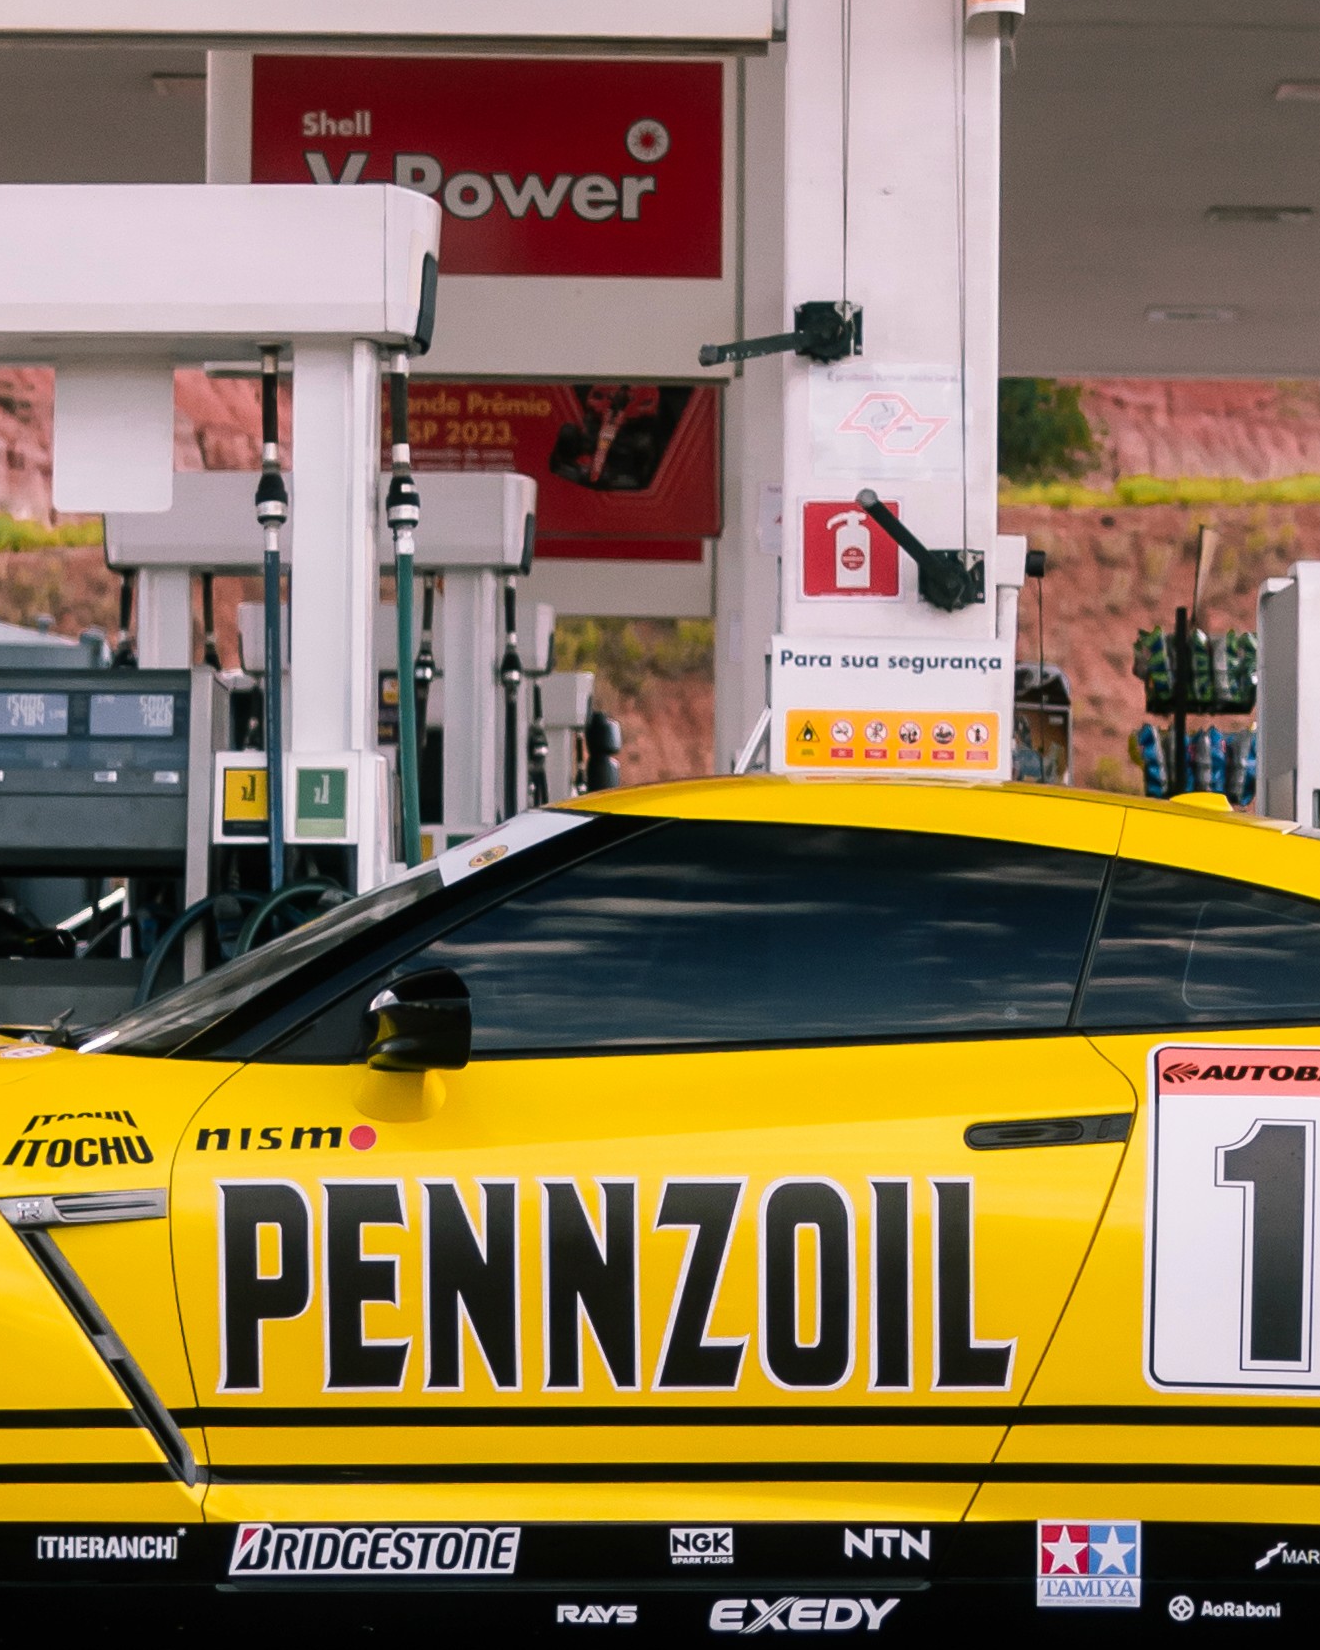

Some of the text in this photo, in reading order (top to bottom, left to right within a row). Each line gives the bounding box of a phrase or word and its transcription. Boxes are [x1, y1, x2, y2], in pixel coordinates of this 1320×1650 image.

[302, 111, 371, 137] Shell
[304, 152, 656, 221] VPower
[780, 649, 1002, 674] Para sua segurança
[2, 1136, 154, 1168] ITOCHU
[1215, 1118, 1316, 1372] 1
[214, 1175, 1019, 1394] PENNZOIL
[234, 1526, 516, 1571] BRIDGESTONE
[671, 1532, 731, 1554] NGK
[844, 1528, 931, 1561] NTN
[671, 1557, 734, 1565] SPARK PLUGS
[1041, 1579, 1137, 1598] TAMIYA
[557, 1605, 638, 1624] RAYS
[709, 1597, 901, 1634] EXEDY
[1201, 1601, 1281, 1618] AoRaboni
